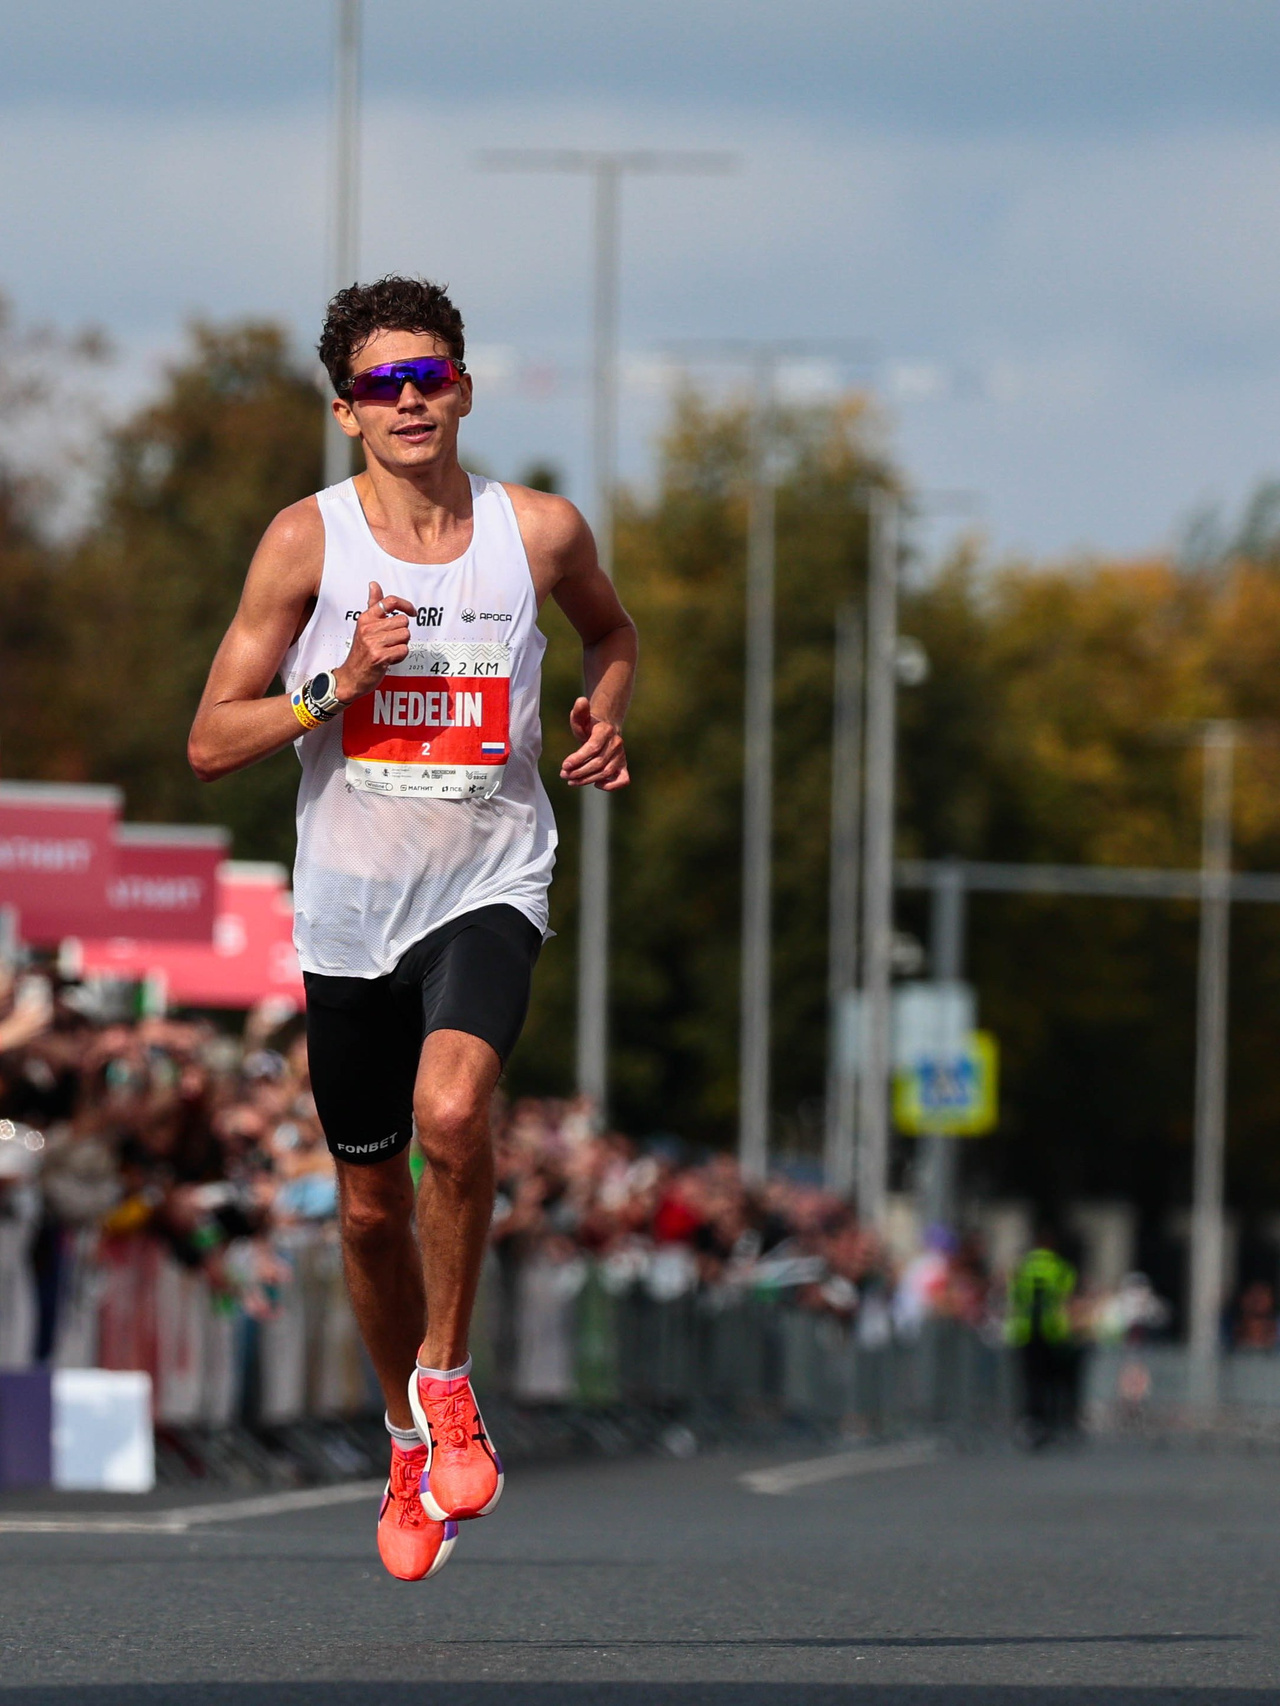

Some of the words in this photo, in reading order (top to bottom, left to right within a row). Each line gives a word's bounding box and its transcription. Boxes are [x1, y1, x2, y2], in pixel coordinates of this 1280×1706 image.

[417, 607, 443, 626] GRi
[430, 662, 467, 676] 42,2
[373, 690, 482, 727] NEDELIN
[422, 743, 431, 756] 2
[337, 1132, 398, 1153] FONBET
